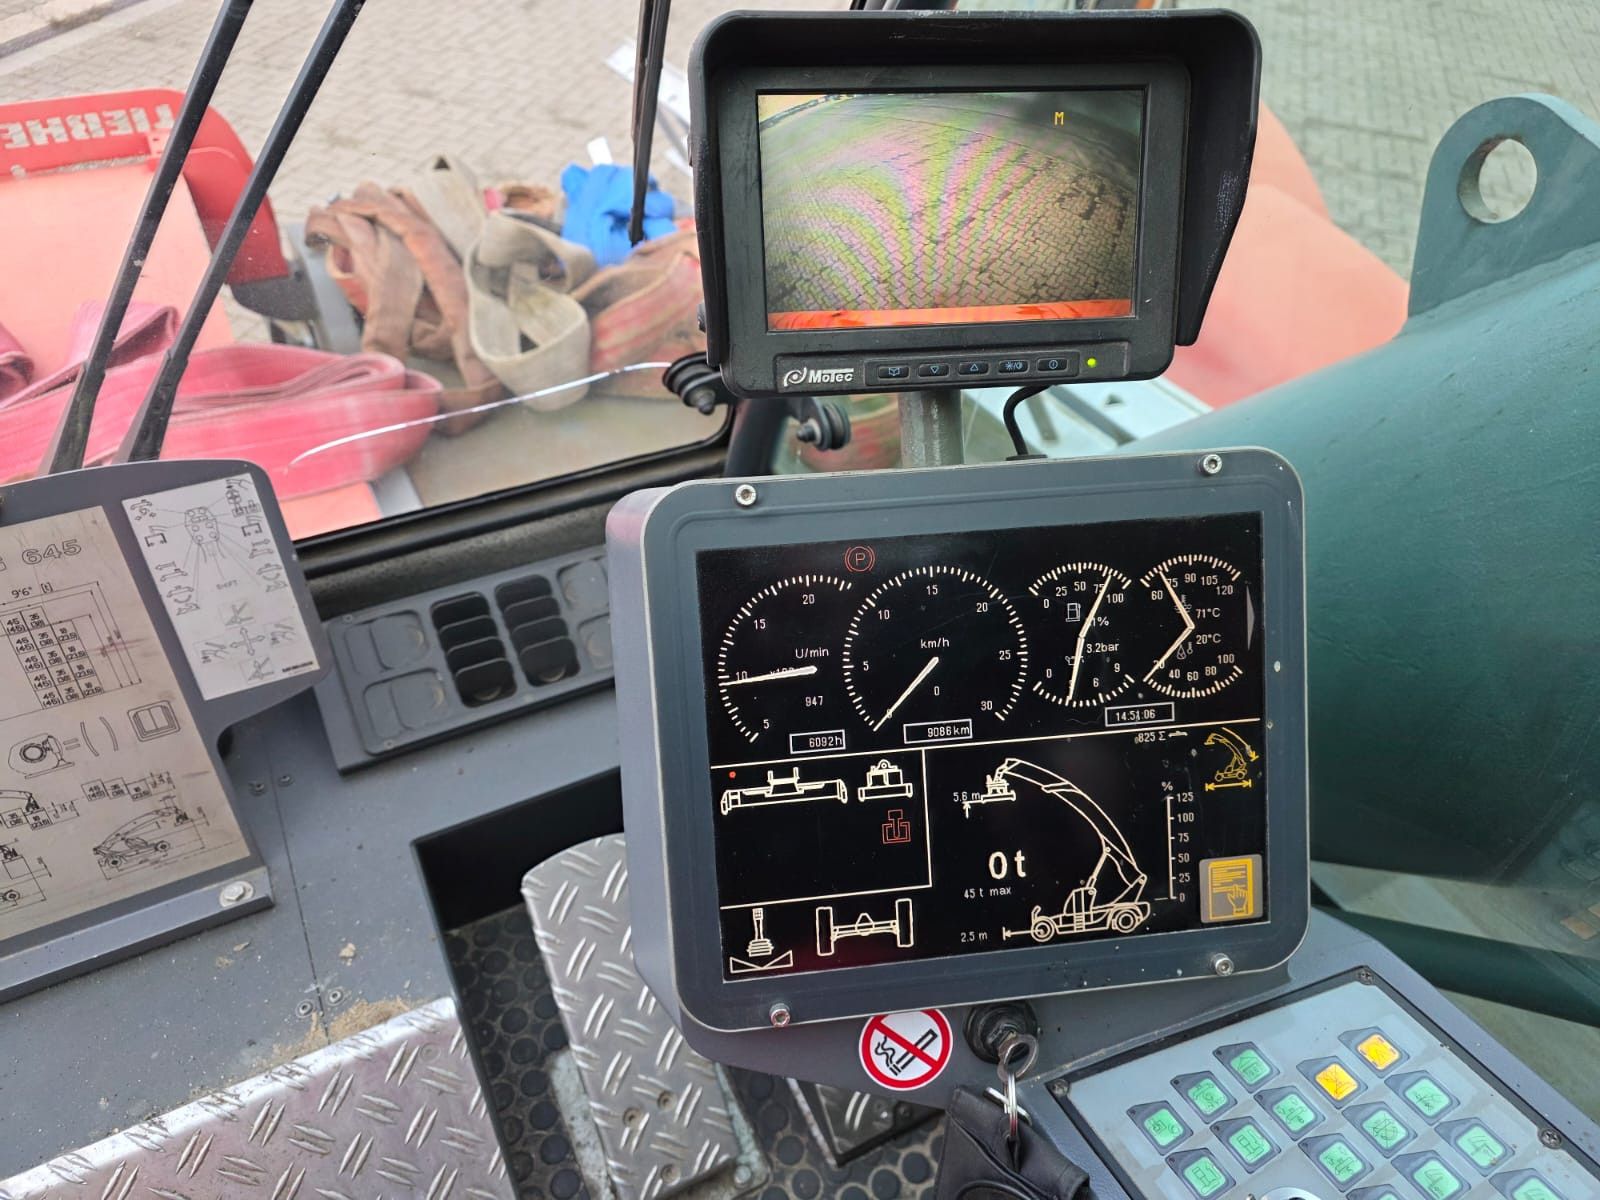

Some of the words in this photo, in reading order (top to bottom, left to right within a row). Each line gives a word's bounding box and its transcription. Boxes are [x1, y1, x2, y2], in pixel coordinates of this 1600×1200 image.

[1054, 111, 1065, 125] M
[21, 539, 82, 565] 645
[855, 553, 865, 565] P
[1184, 573, 1197, 583] 90
[1201, 575, 1218, 586] 105
[926, 585, 938, 595] 15
[1074, 581, 1087, 591] 50
[1216, 585, 1234, 595] 120
[1055, 586, 1068, 597] 25
[1151, 590, 1163, 600] 60
[802, 595, 815, 605] 20
[1106, 593, 1124, 604] 100
[976, 602, 988, 613] 20
[879, 610, 890, 620] 10
[753, 619, 766, 630] 15
[920, 638, 950, 649] km/h
[795, 647, 829, 659] U/min
[999, 650, 1011, 660] 25
[1217, 653, 1235, 665] 100
[736, 671, 748, 681] 10
[1168, 669, 1180, 679] 40
[1187, 671, 1199, 681] 60
[1205, 666, 1217, 676] 80
[805, 696, 824, 707] 947
[980, 700, 993, 711] 30
[1161, 781, 1173, 791] %
[1176, 792, 1194, 802] 125
[1177, 812, 1195, 823] 100
[1178, 833, 1190, 843] 75
[1178, 853, 1190, 863] 50
[988, 851, 1008, 880] 0
[1014, 850, 1027, 877] t
[1179, 873, 1191, 883] 25
[964, 888, 976, 899] 45
[989, 886, 1012, 897] max
[960, 931, 975, 943] 2.5
